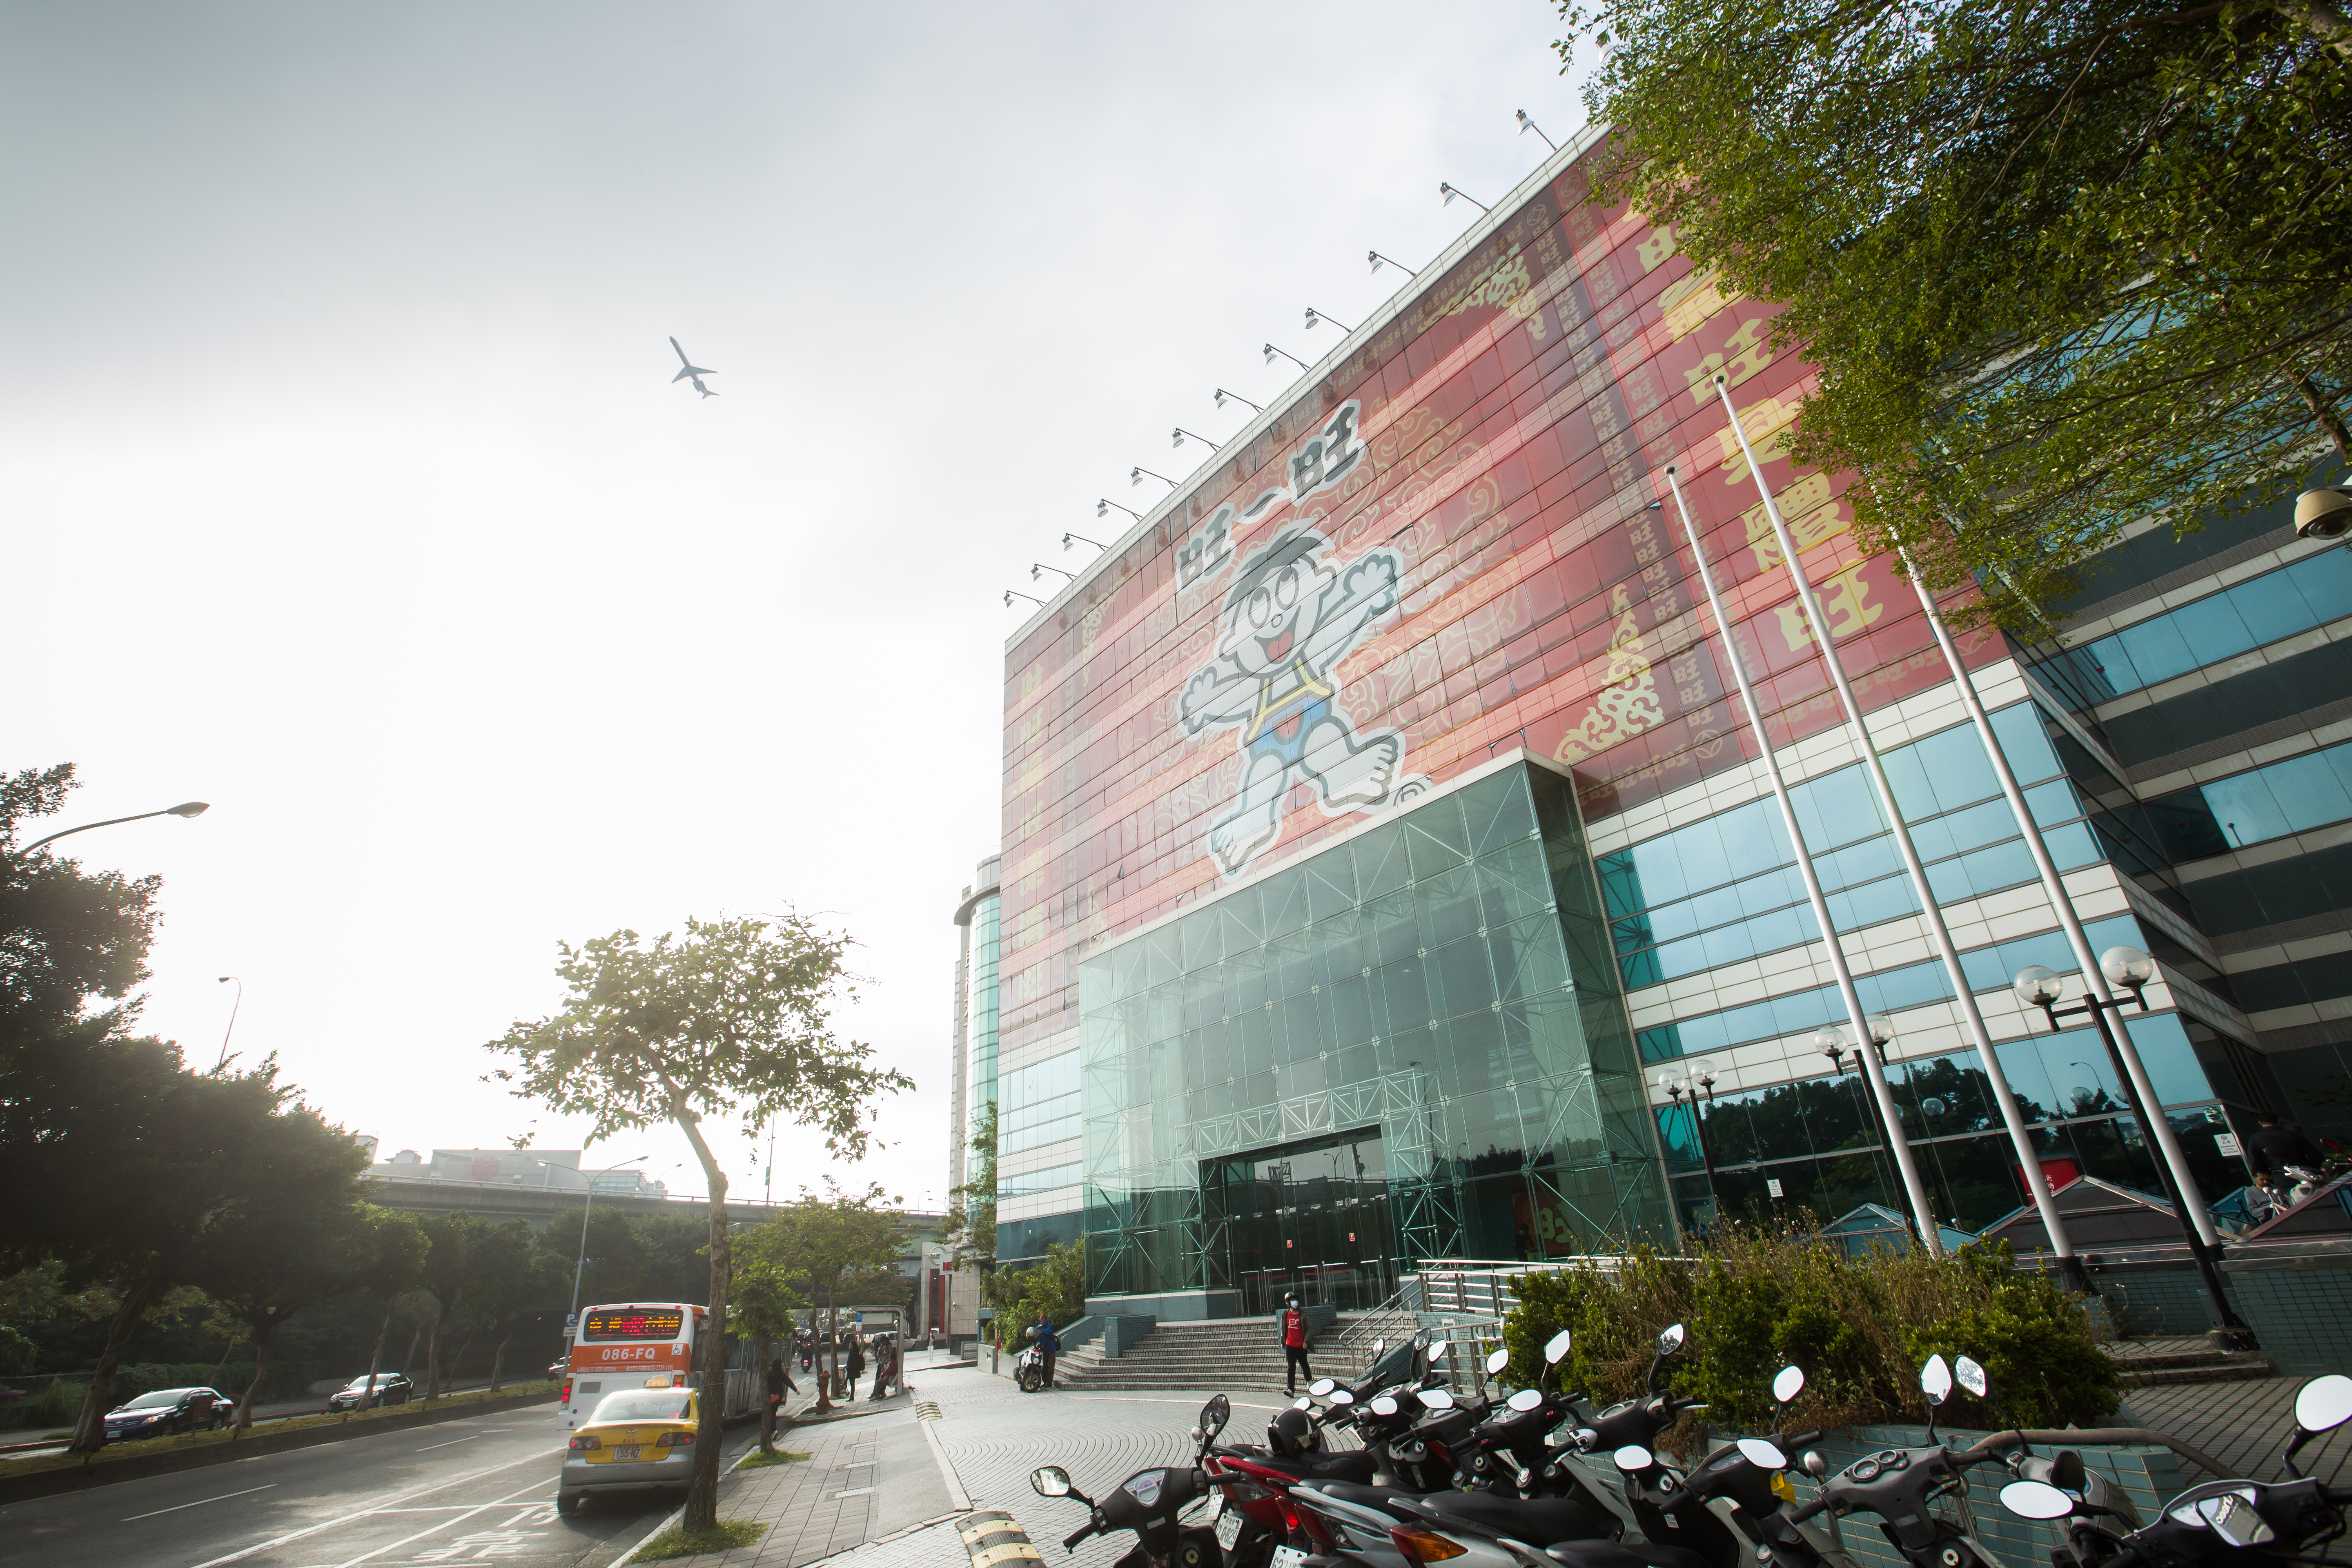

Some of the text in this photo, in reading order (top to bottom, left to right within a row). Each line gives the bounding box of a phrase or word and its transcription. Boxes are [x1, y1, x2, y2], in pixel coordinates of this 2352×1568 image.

[1177, 403, 1362, 592] 旺一旺
[567, 1314, 575, 1323] P
[602, 1348, 655, 1360] 086-FQ
[617, 1448, 641, 1459] 155-NZ
